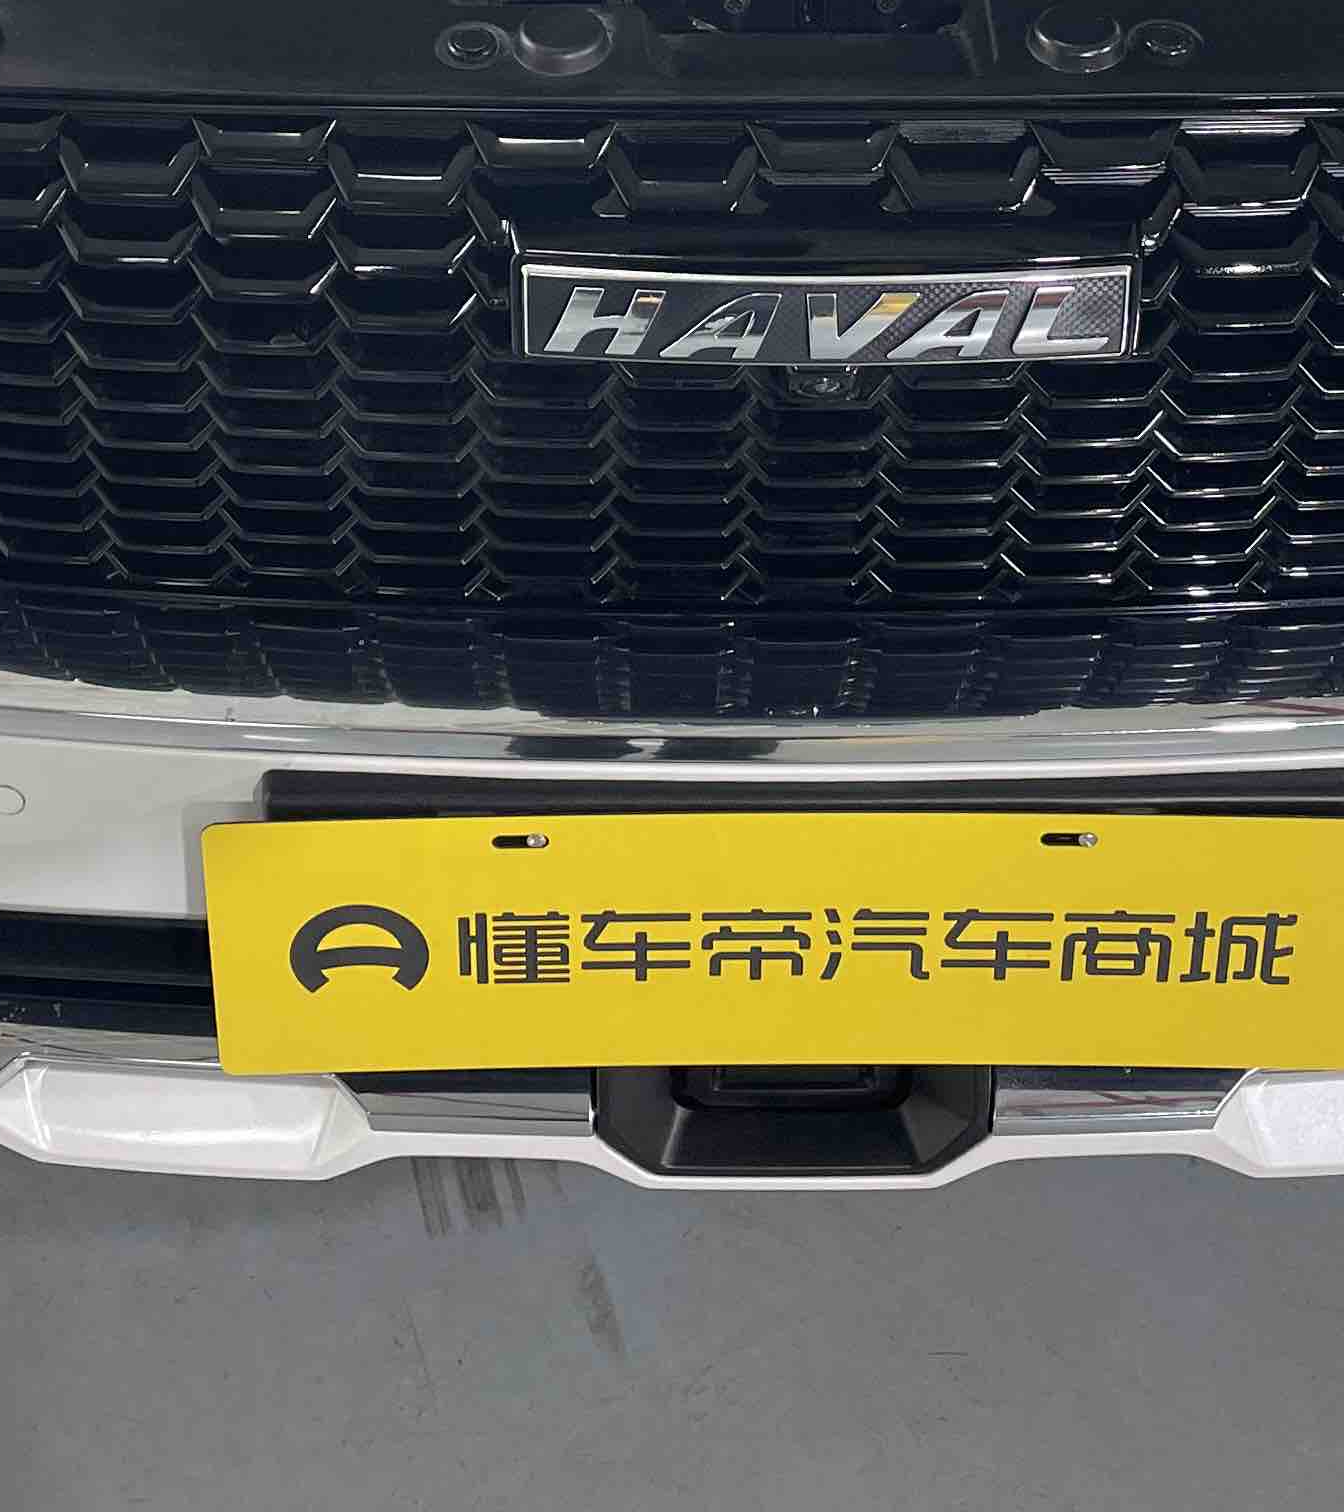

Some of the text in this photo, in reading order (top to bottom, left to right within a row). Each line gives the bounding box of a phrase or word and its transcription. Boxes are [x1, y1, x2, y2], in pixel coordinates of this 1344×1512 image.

[544, 287, 1110, 359] HAVAL
[457, 909, 1298, 987] 懂车帝汽车商城
